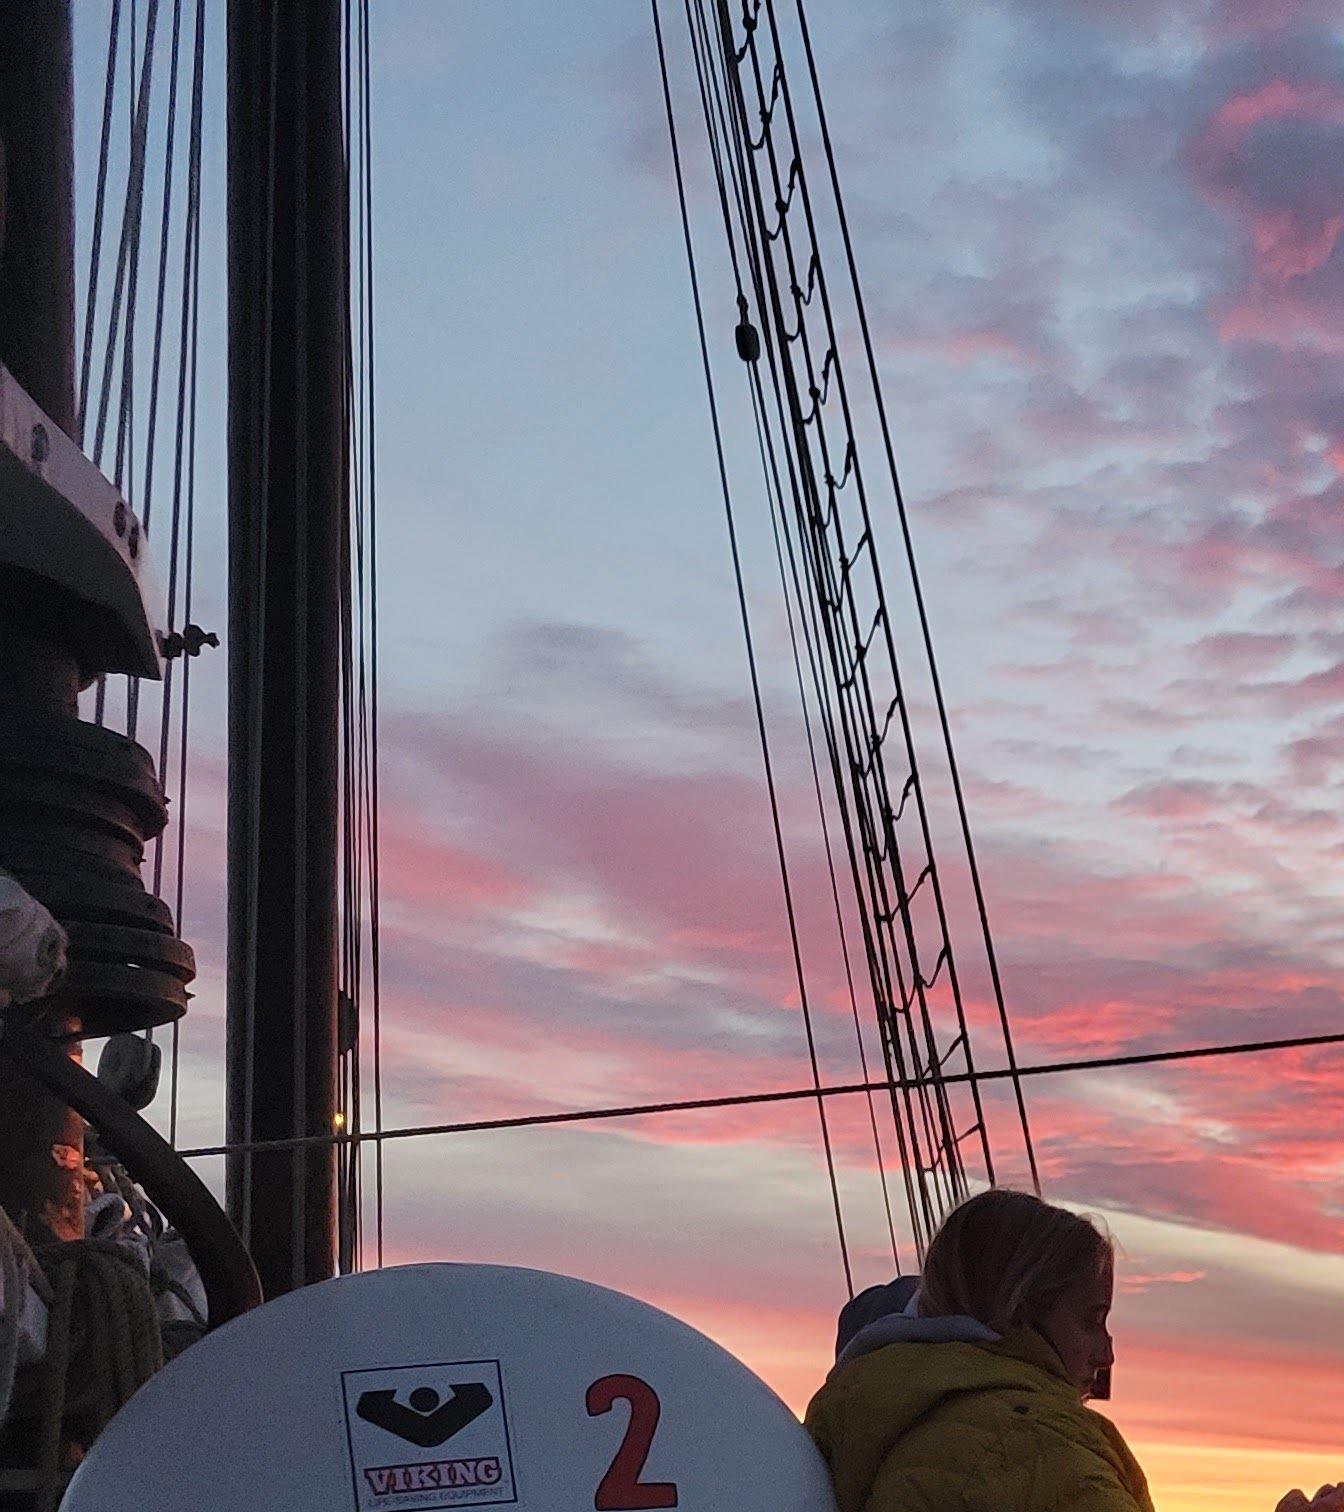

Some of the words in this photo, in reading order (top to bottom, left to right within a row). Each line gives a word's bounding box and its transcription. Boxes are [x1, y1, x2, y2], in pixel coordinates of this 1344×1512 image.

[586, 1374, 678, 1511] 2
[364, 1456, 501, 1496] VIKING
[440, 1486, 504, 1501] EQUIPMENT
